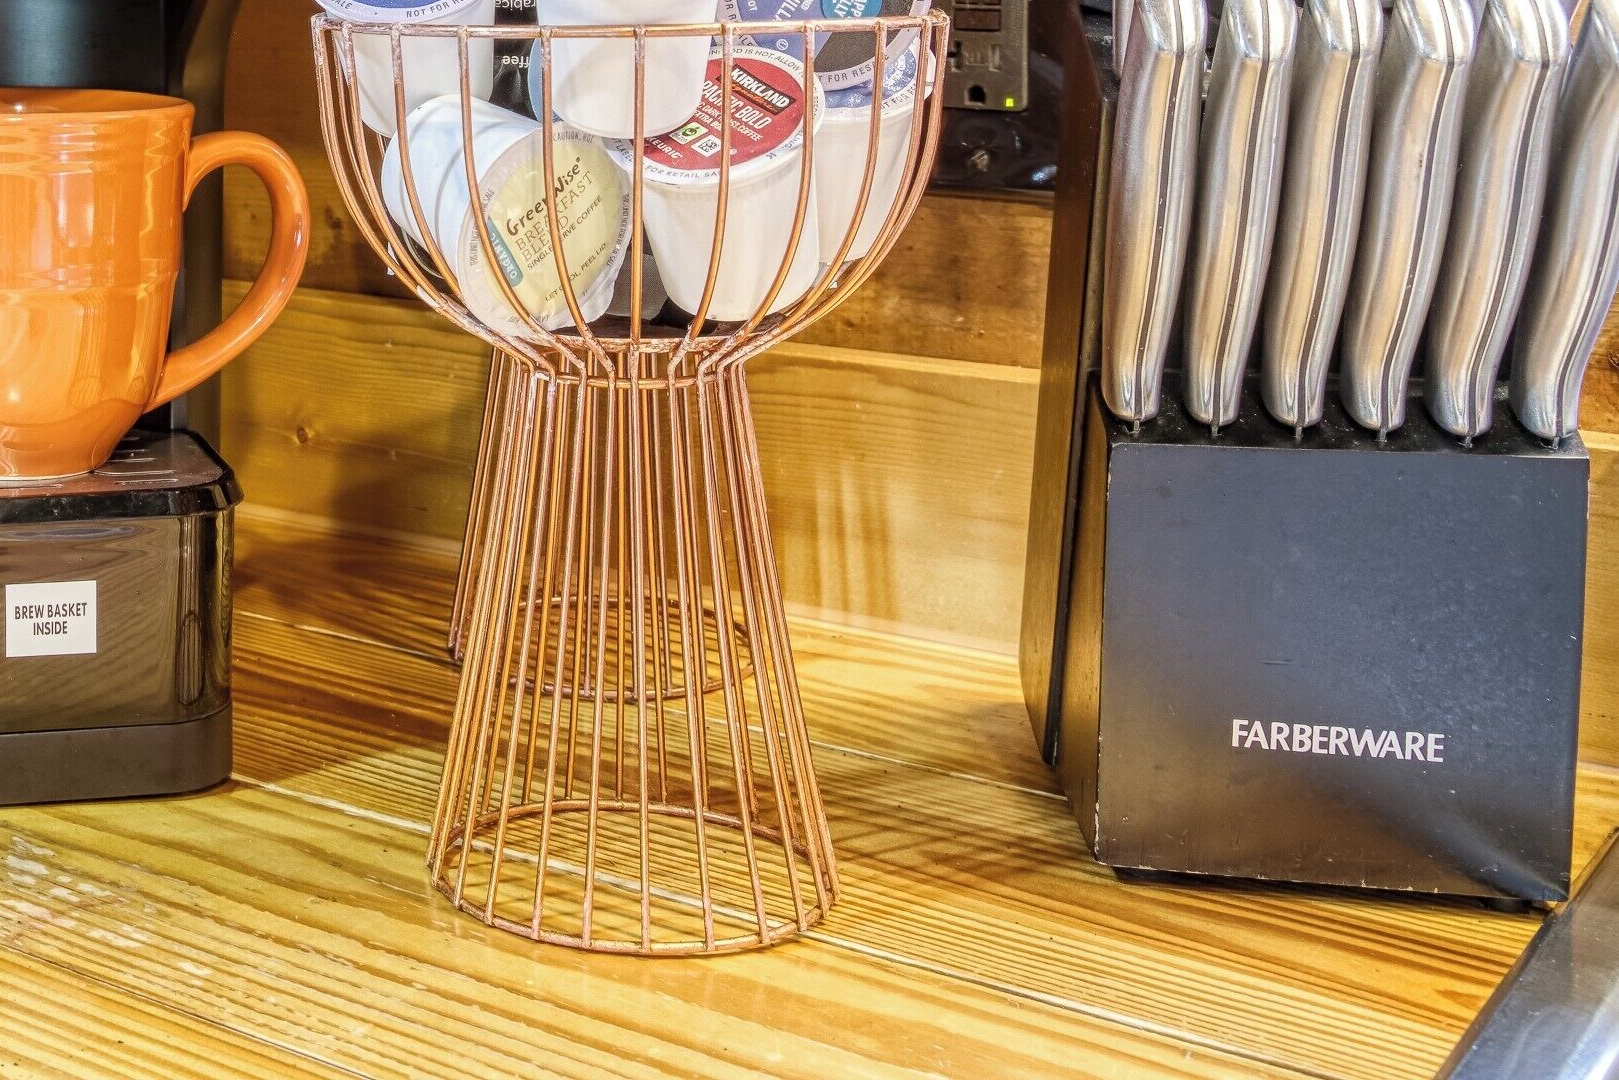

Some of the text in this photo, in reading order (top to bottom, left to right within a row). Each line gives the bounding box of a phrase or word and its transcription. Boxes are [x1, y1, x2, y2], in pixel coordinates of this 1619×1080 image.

[406, 8, 426, 18] NOT
[430, 1, 450, 14] FOR
[828, 74, 848, 83] FOR
[852, 54, 890, 77] RESE
[730, 67, 790, 108] KIRKLAND
[734, 105, 773, 130] BOLD
[737, 125, 763, 143] COFFEE
[646, 137, 683, 159] KEURIG
[645, 165, 665, 175] FOR
[666, 170, 700, 179] RETAIL
[576, 195, 603, 226] COFFEE
[521, 214, 570, 262] BLED
[580, 251, 597, 271] PEEL
[595, 242, 607, 256] LID
[14, 602, 88, 620] BREW BASKET
[33, 620, 68, 636] INSIDE
[1231, 719, 1444, 763] FARBERWARE
